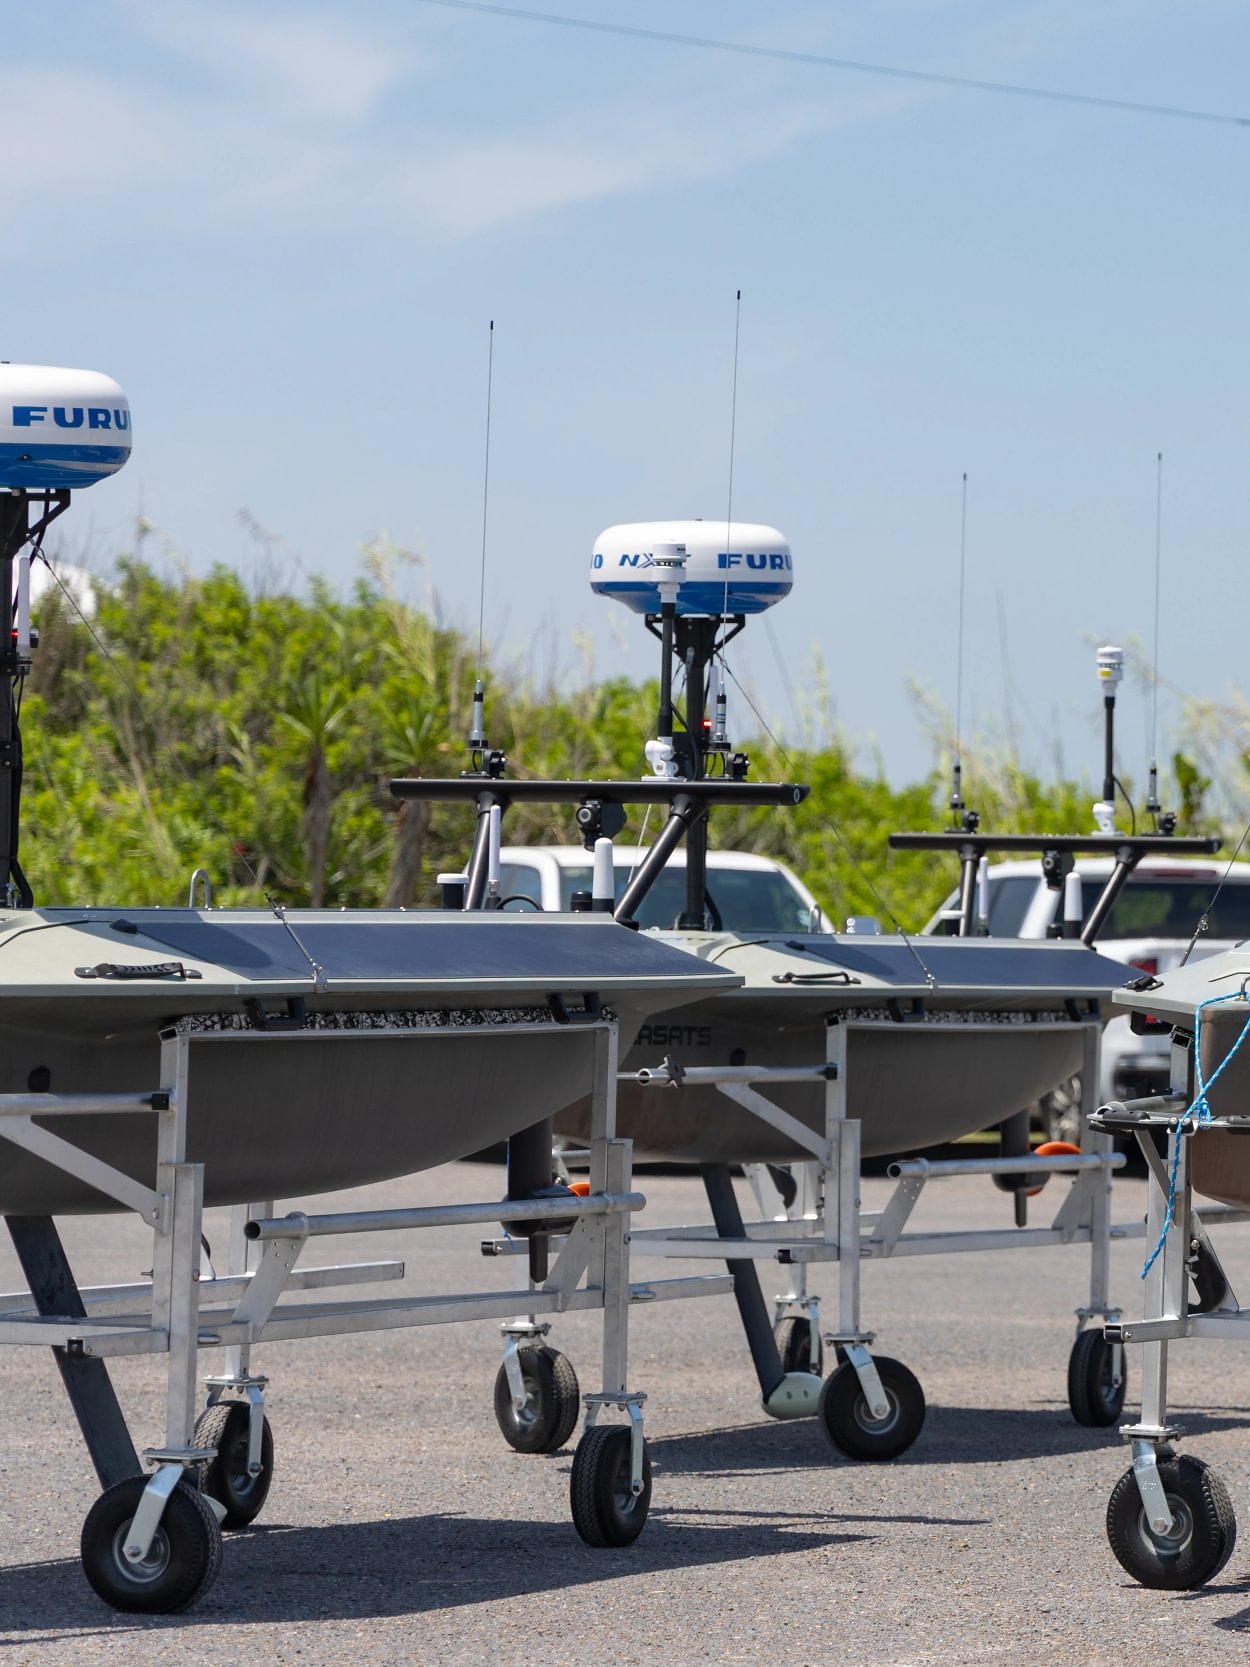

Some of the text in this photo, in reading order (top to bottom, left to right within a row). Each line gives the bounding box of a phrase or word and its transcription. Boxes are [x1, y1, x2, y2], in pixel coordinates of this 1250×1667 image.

[12, 405, 132, 431] FURU
[590, 553, 604, 569] O
[618, 553, 692, 568] NX
[633, 1024, 713, 1047] ASATS
